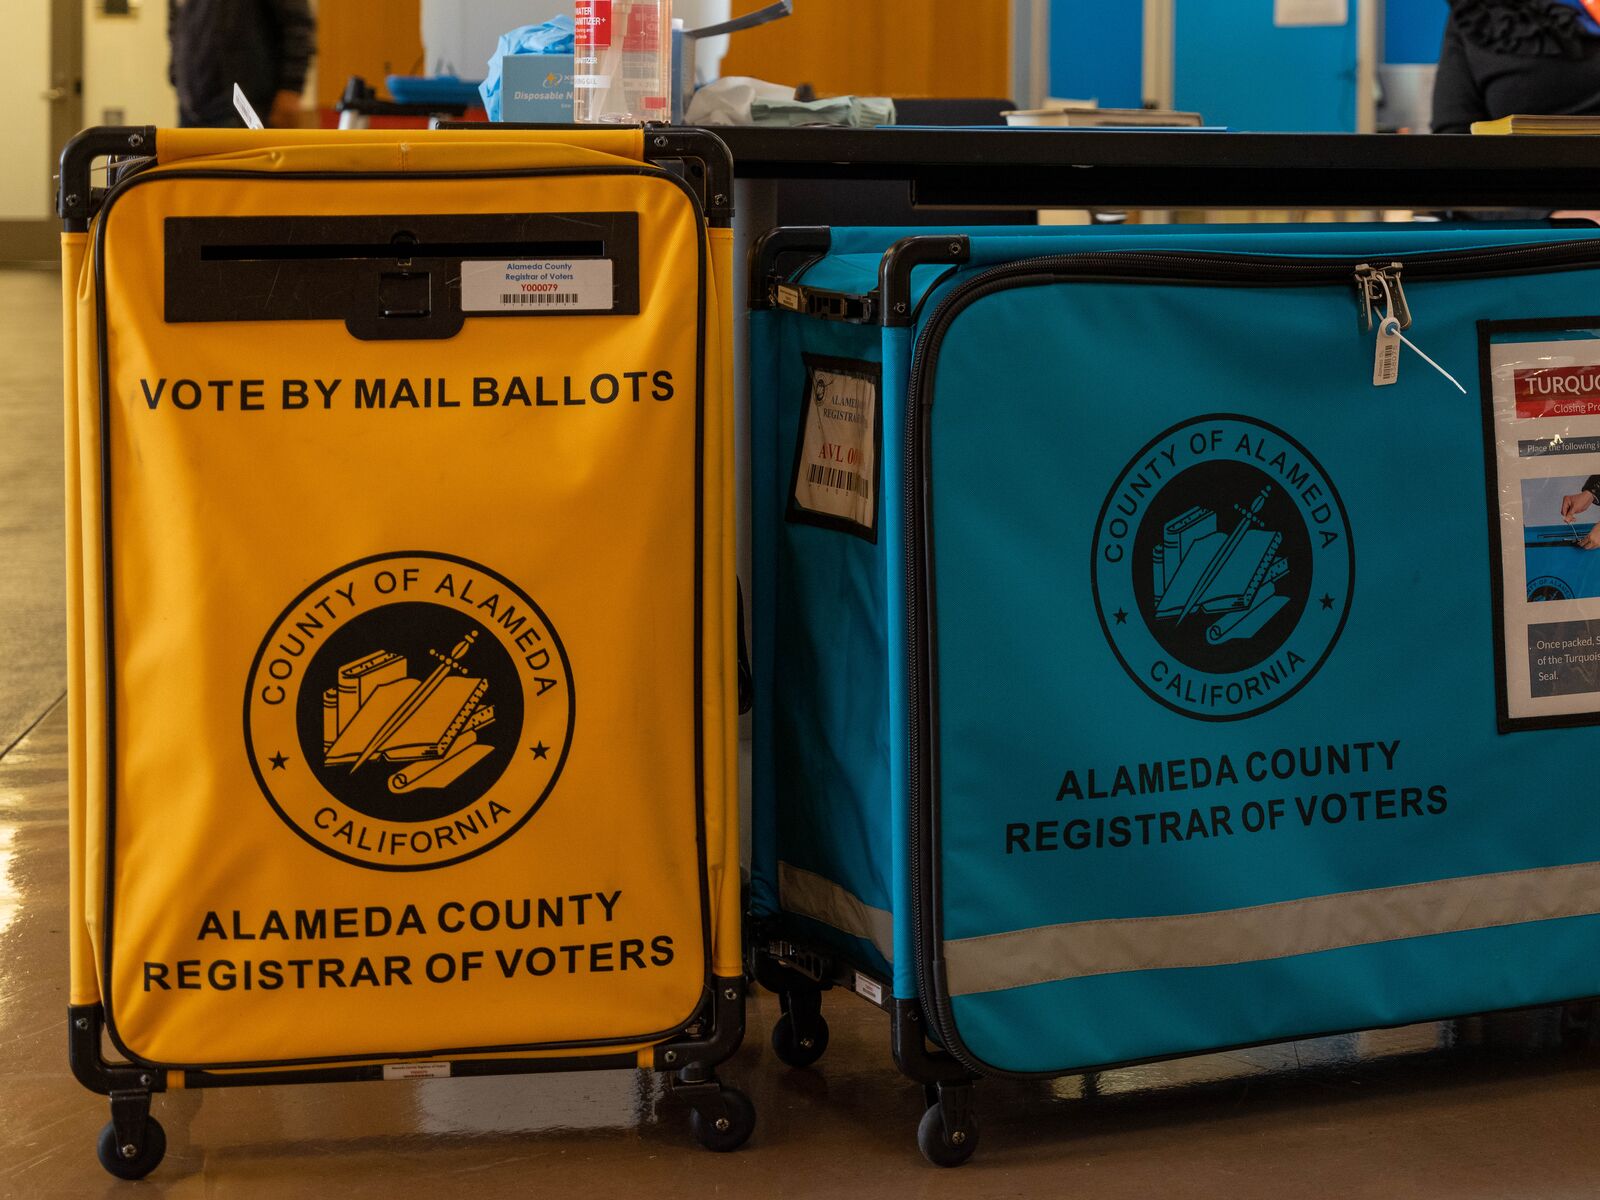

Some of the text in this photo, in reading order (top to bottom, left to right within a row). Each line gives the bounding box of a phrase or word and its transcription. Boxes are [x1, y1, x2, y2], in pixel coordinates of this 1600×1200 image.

[514, 91, 574, 101] Disposable N
[505, 273, 538, 281] Registrar
[545, 263, 572, 272] County
[521, 284, 558, 292] Y000079
[139, 370, 675, 411] VOTE BY MAIL BALLOTS
[1554, 402, 1586, 414] Closing
[819, 443, 843, 462] AVL
[1527, 443, 1547, 453] Place
[1549, 442, 1560, 451] the
[1562, 440, 1595, 452] following
[1105, 430, 1338, 564] COUNTY OF ALAMEDA
[261, 568, 558, 706] COUNTY OF ALAMEDA
[1536, 640, 1561, 650] Once
[1562, 637, 1595, 650] packed,
[1537, 656, 1547, 665] of
[1548, 655, 1563, 664] the
[1151, 650, 1306, 707] CALIFORNIA
[1538, 671, 1559, 681] Seal.
[1056, 740, 1401, 801] ALAMEDA COUNTY
[313, 800, 512, 856] CALIFORNIA
[1006, 785, 1448, 855] REGISTRAR OF VOTERS
[197, 890, 623, 941] ALAMEDA COUNTY
[144, 935, 675, 992] REGISTRAR OF VOTERS
